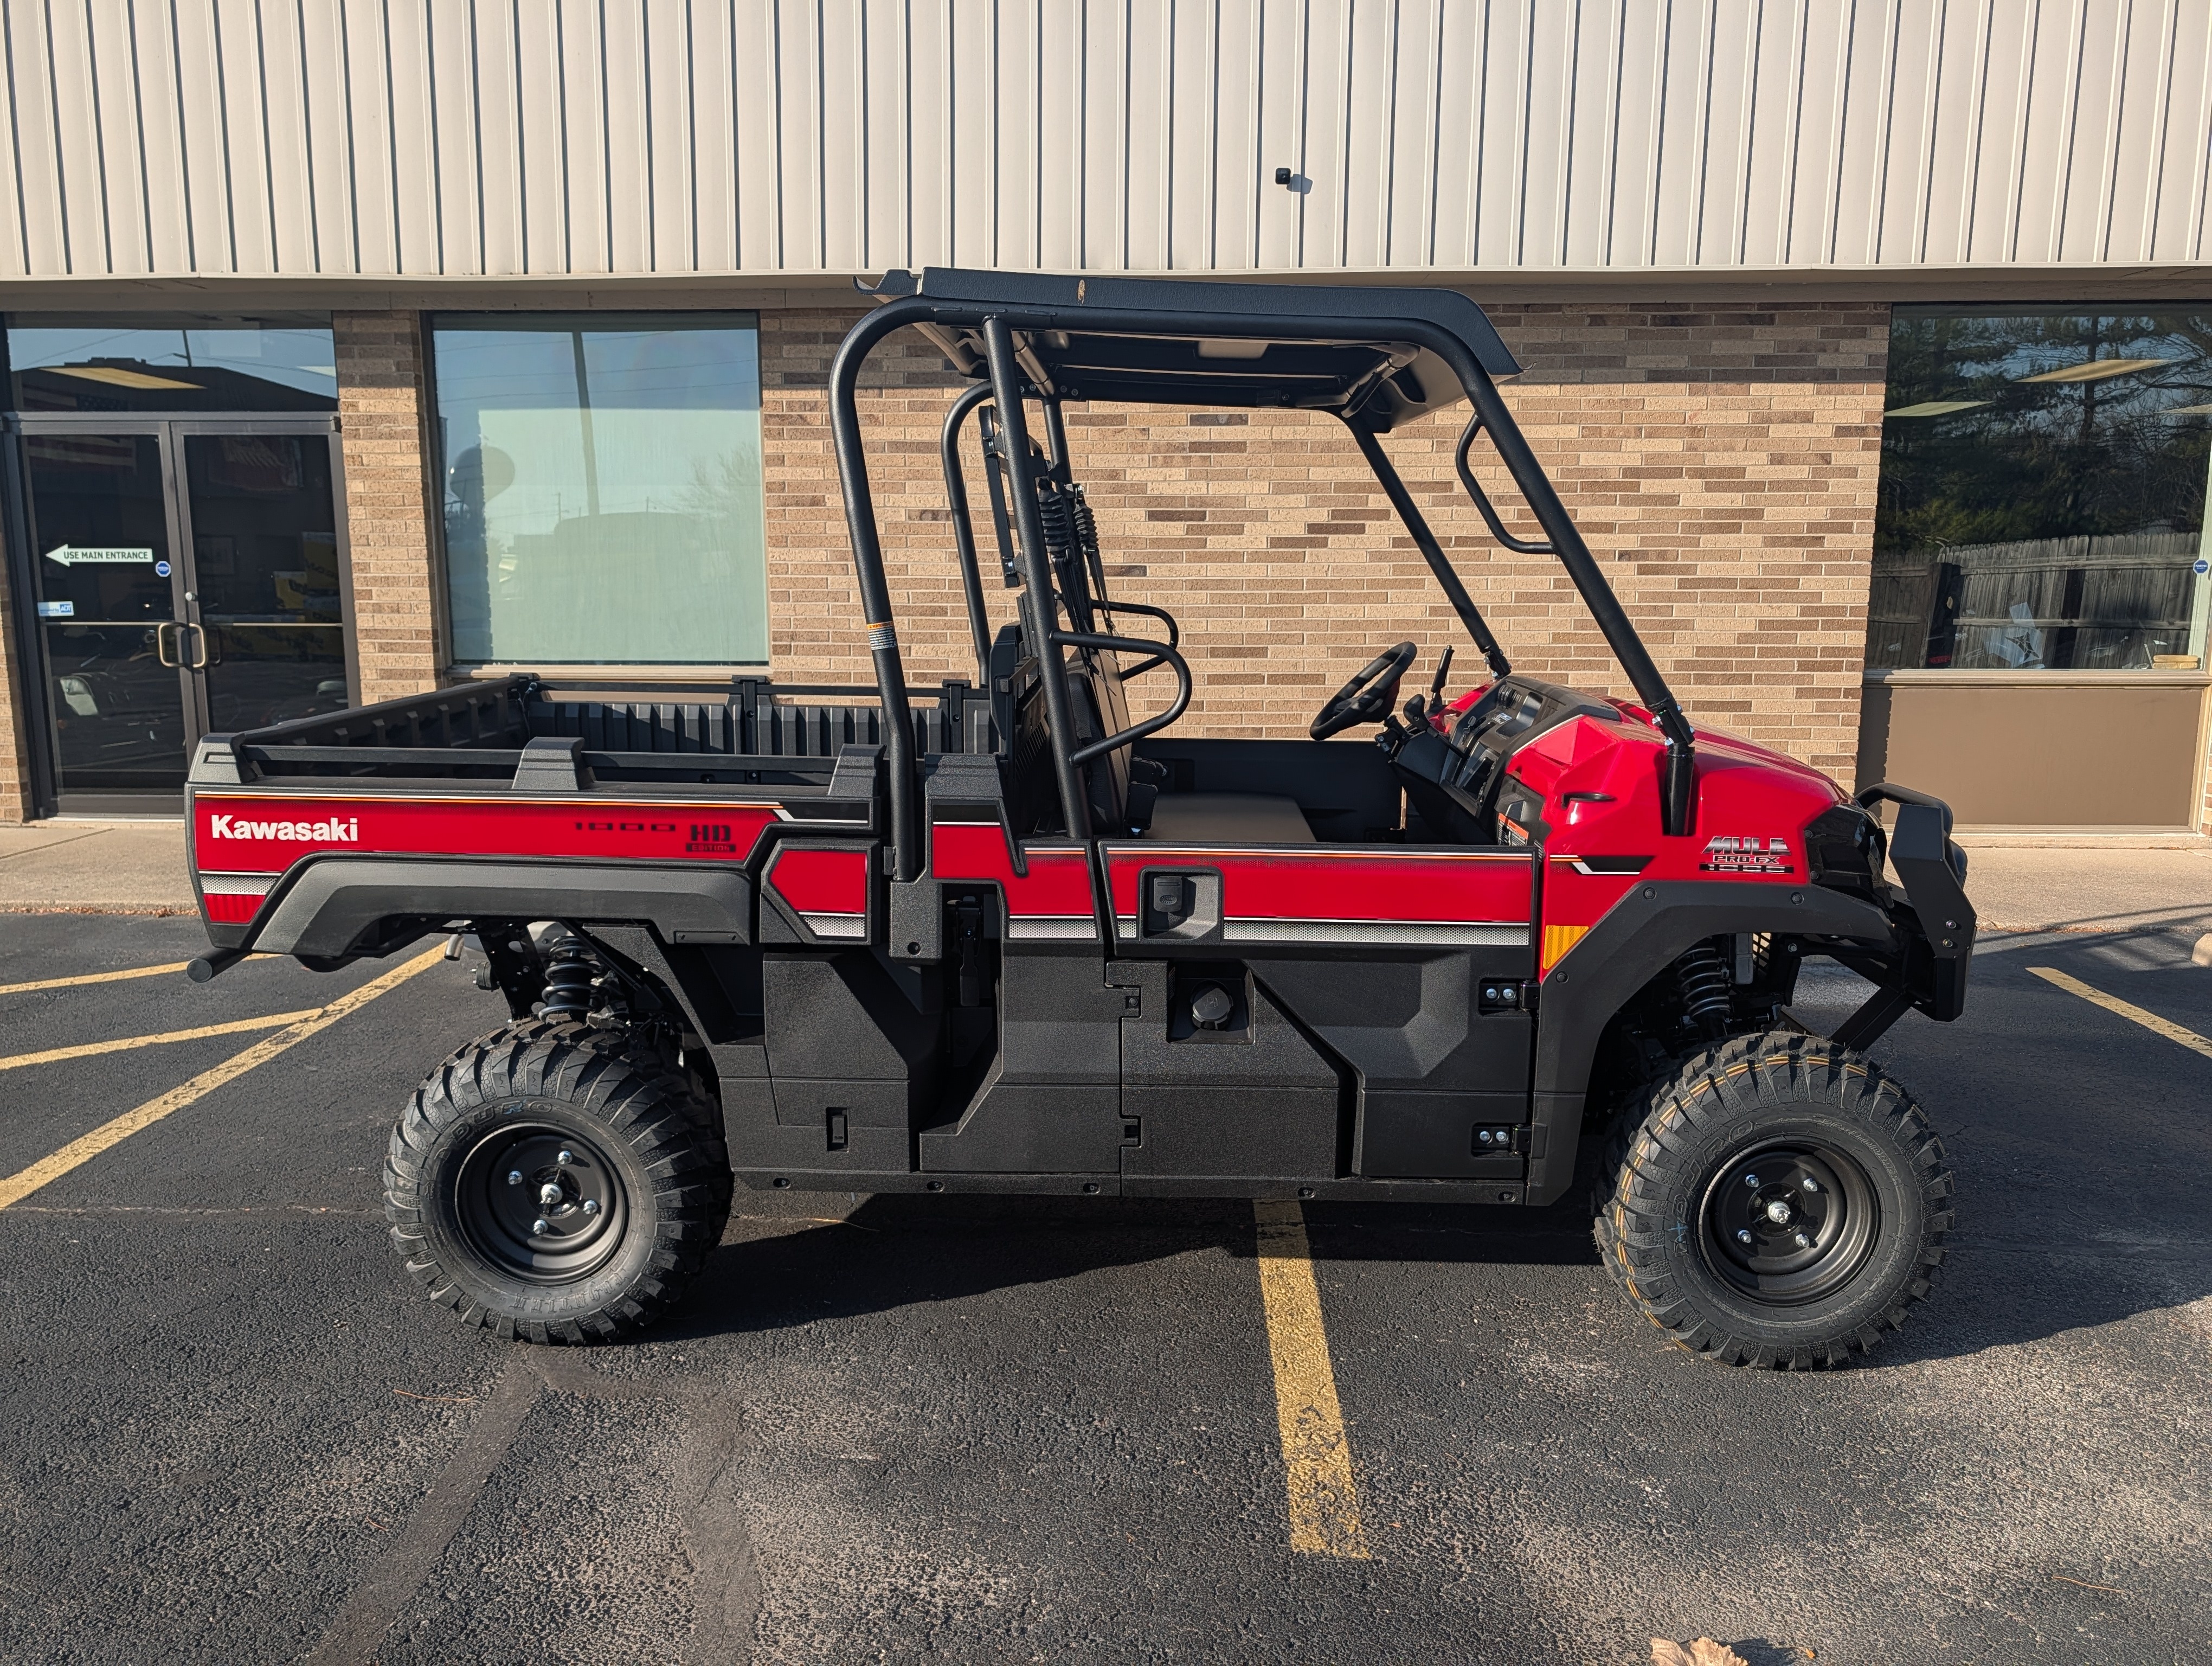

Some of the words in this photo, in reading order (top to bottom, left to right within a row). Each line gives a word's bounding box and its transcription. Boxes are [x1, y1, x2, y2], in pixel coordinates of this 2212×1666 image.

[63, 551, 79, 560] USE
[81, 551, 104, 560] MAIN
[105, 551, 148, 560] ENTRANCE
[211, 815, 358, 842] Kawasaki
[574, 822, 676, 832] 1000
[690, 824, 731, 842] HD
[1701, 836, 1792, 856] MULE
[1708, 863, 1785, 873] 1000
[1713, 855, 1780, 864] PRO-FX
[451, 1100, 553, 1143] DURO
[1671, 1119, 1755, 1223] DURO
